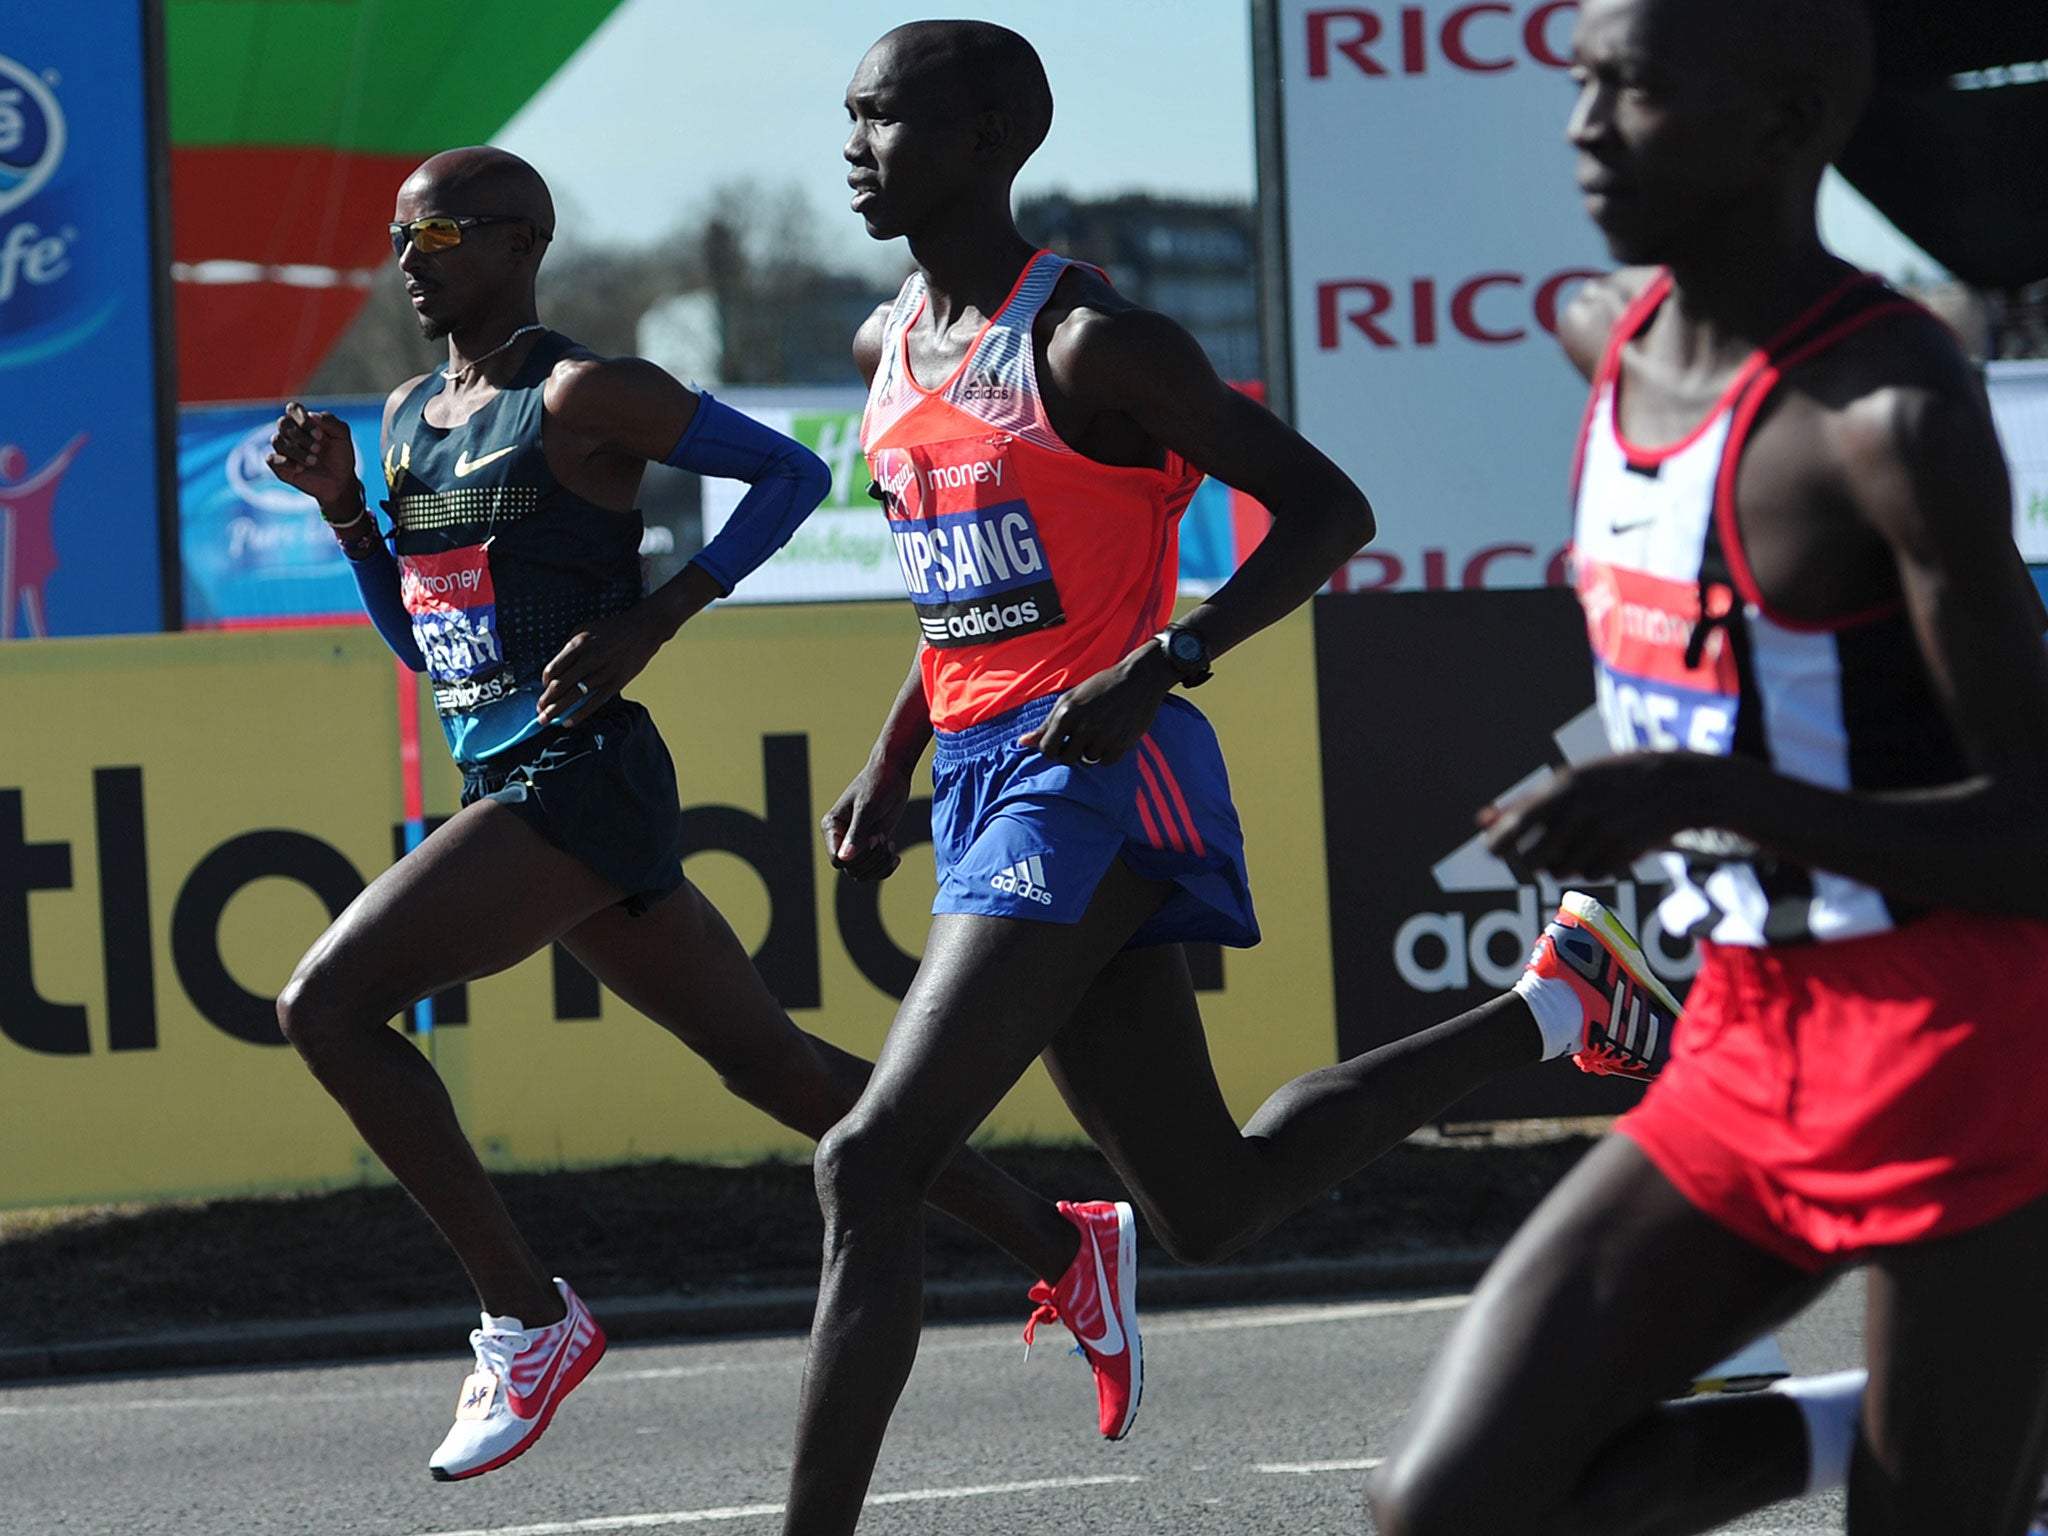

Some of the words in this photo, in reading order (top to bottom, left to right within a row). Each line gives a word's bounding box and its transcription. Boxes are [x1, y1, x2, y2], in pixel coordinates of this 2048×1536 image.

[964, 385, 1009, 401] adidas
[927, 458, 1003, 493] money
[946, 600, 1040, 641] adidas
[990, 875, 1053, 905] adidas
